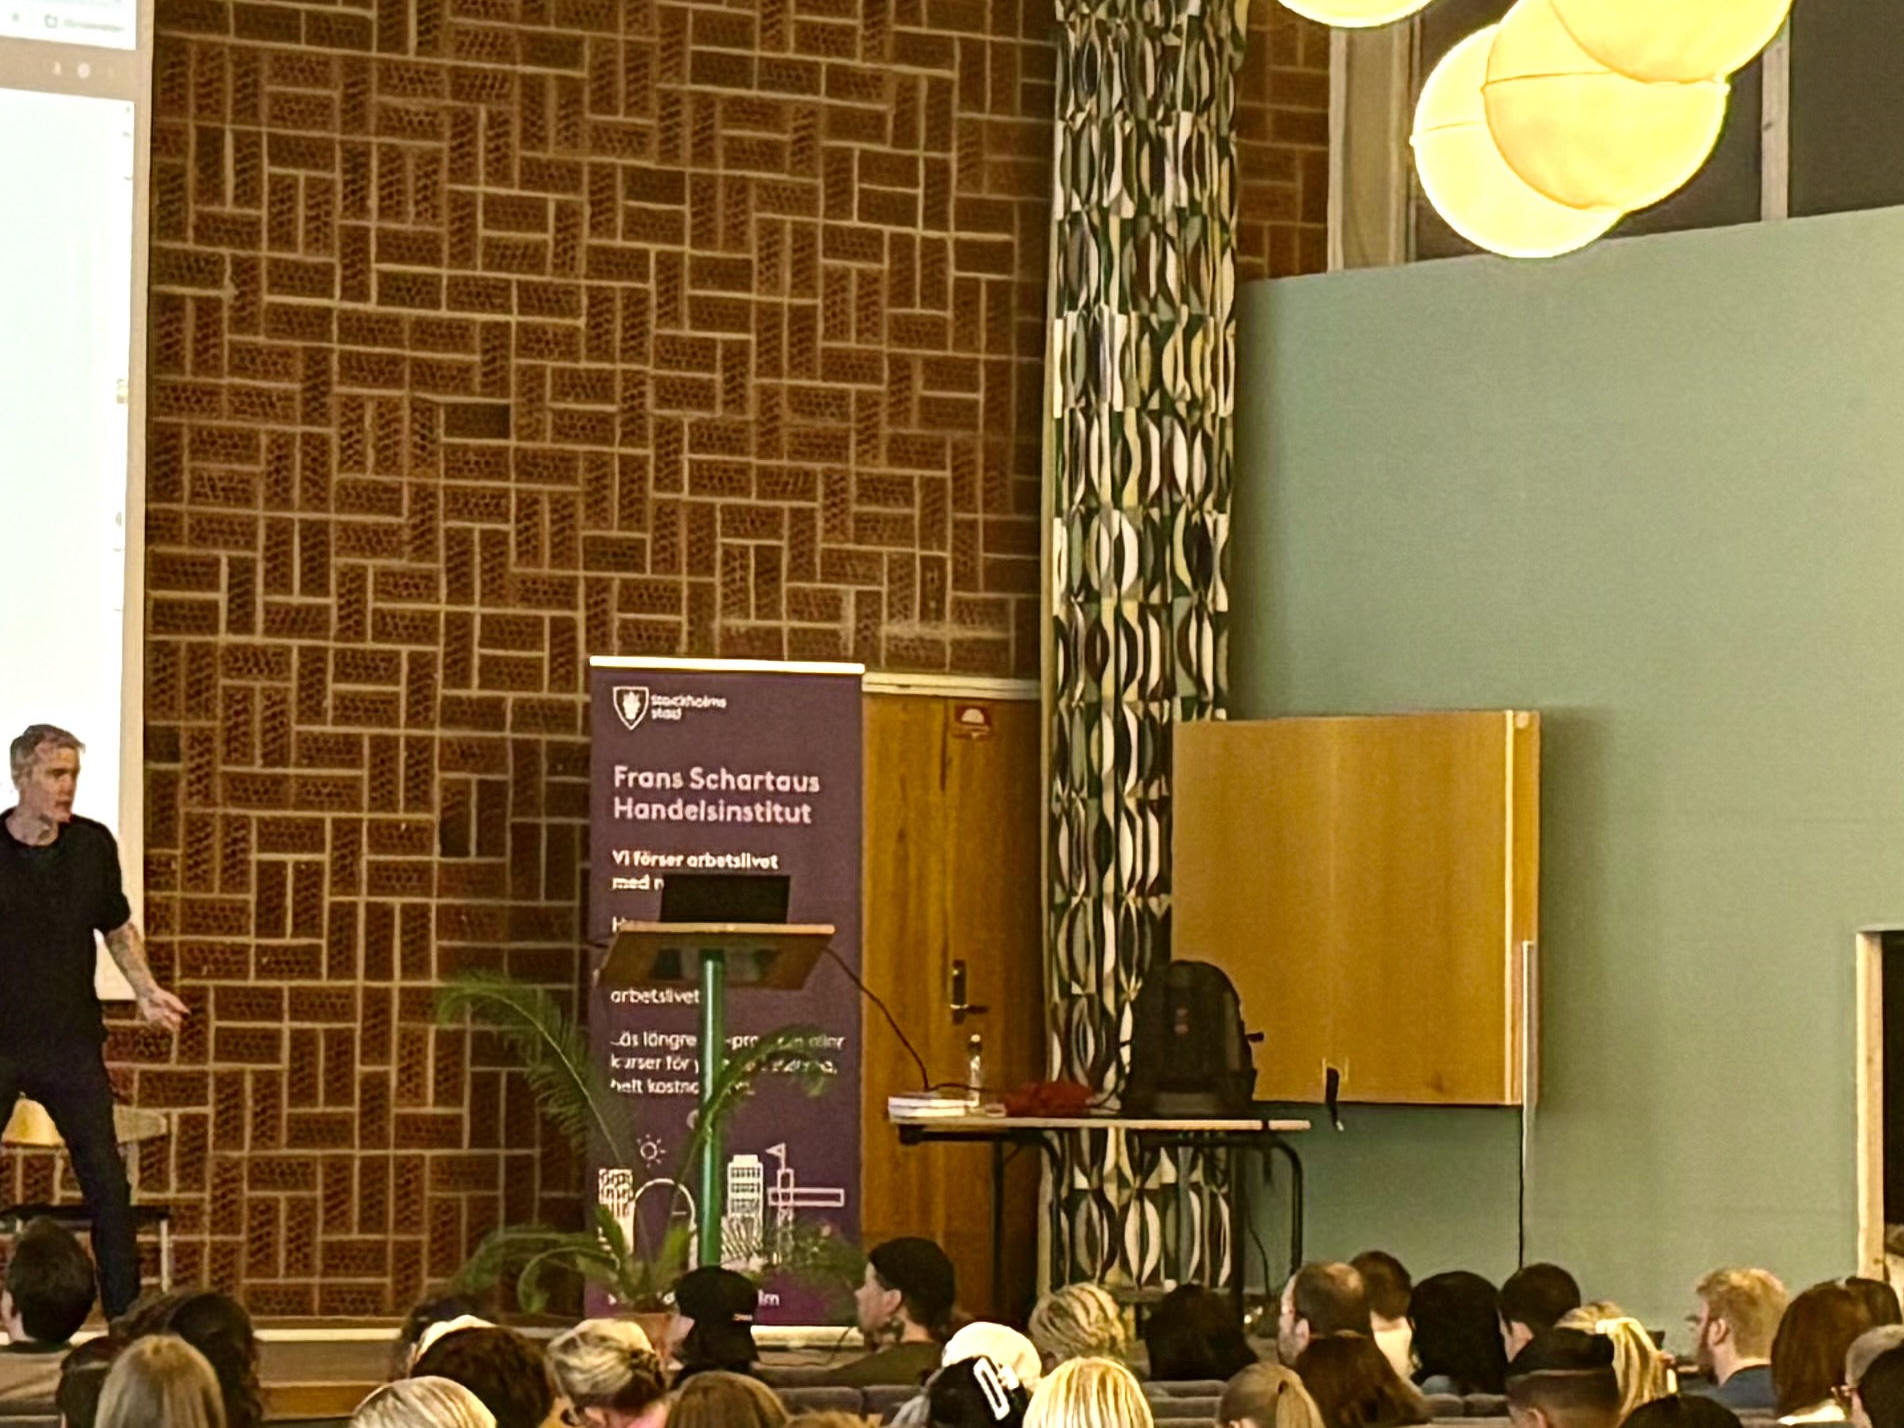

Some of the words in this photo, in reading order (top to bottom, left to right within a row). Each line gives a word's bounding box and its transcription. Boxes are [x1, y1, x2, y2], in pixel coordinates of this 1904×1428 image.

[651, 708, 682, 721] stad
[614, 765, 683, 789] Frans
[690, 767, 820, 793] Schartaus
[614, 797, 811, 824] Handelsinstitut
[612, 850, 629, 866] Vi
[633, 851, 684, 867] förser
[686, 852, 778, 869] arbetslivet
[612, 874, 650, 890] med
[643, 1031, 697, 1051] längre
[666, 1055, 689, 1071] för
